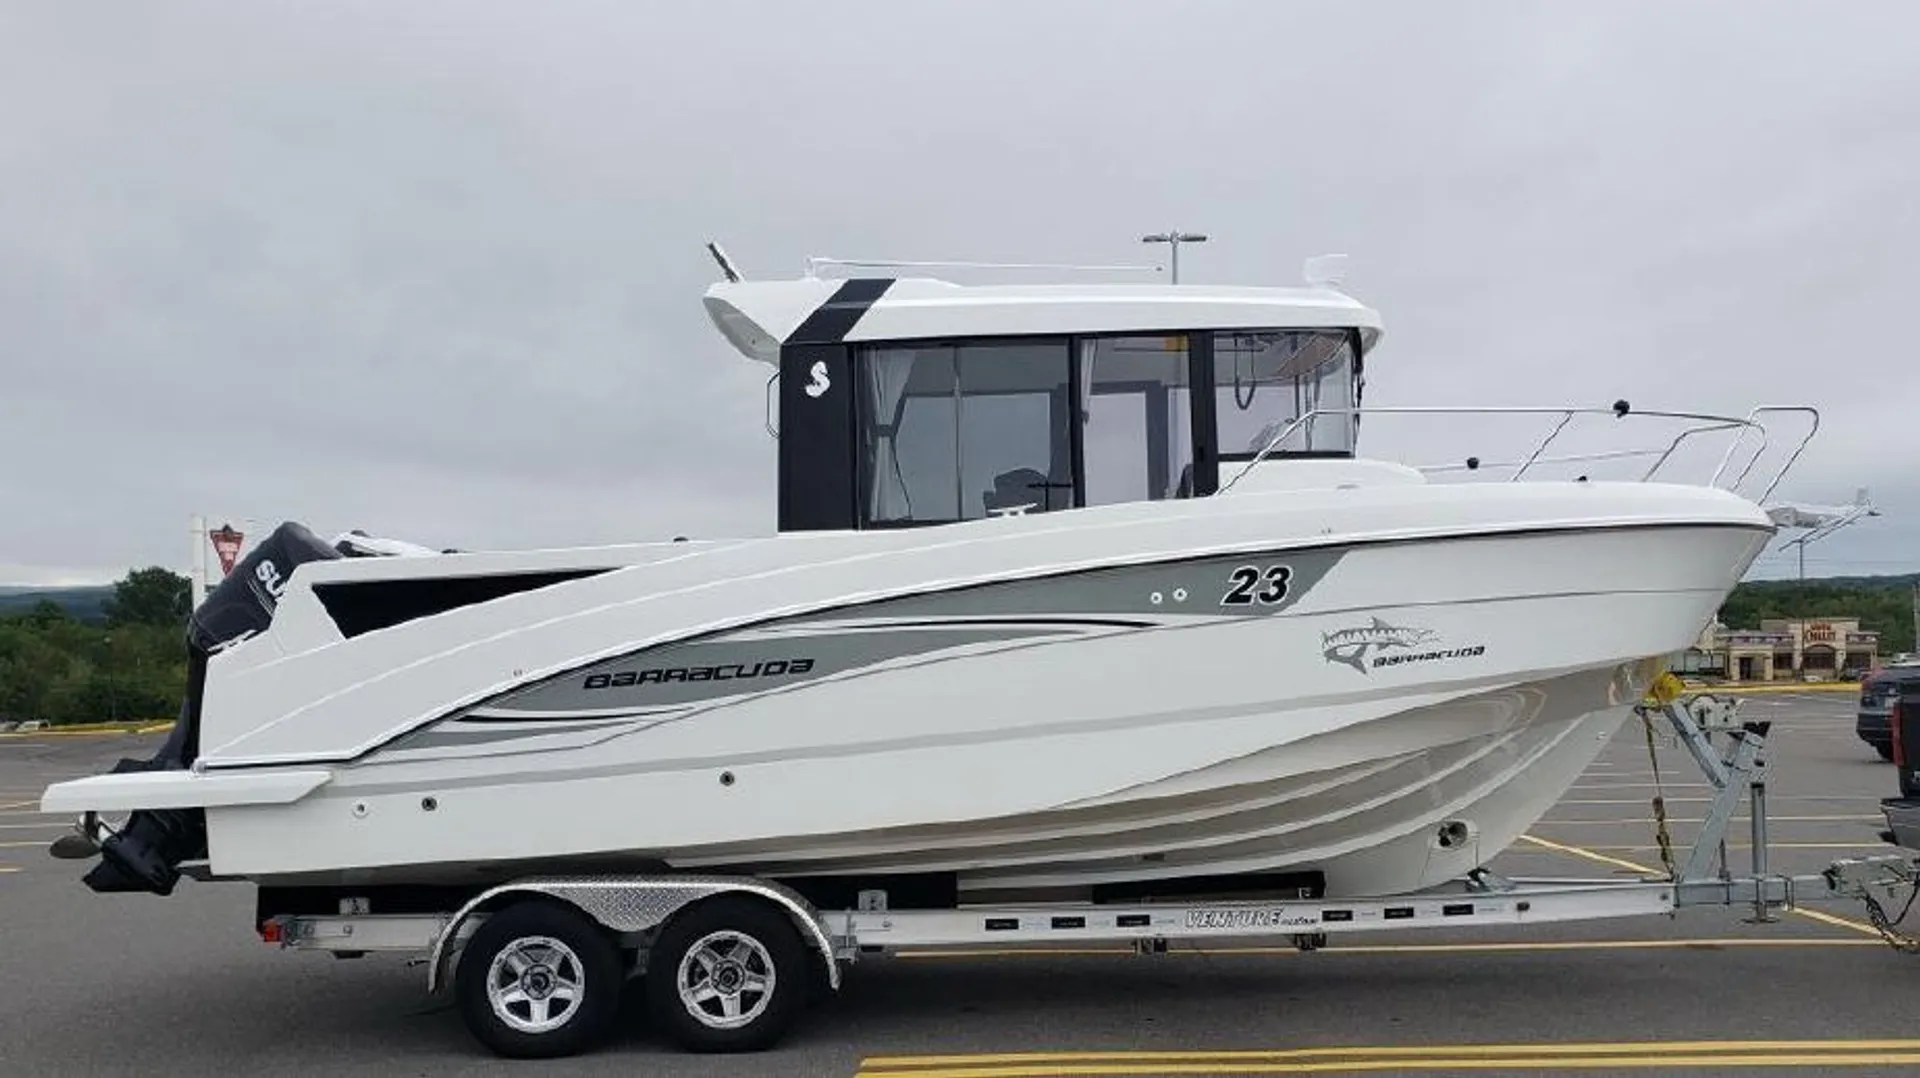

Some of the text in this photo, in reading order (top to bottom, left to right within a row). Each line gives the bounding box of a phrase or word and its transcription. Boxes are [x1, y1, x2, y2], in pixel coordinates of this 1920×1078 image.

[1220, 565, 1293, 606] 23
[583, 658, 815, 689] BARRACUDA
[1185, 907, 1284, 928] VENTURE
